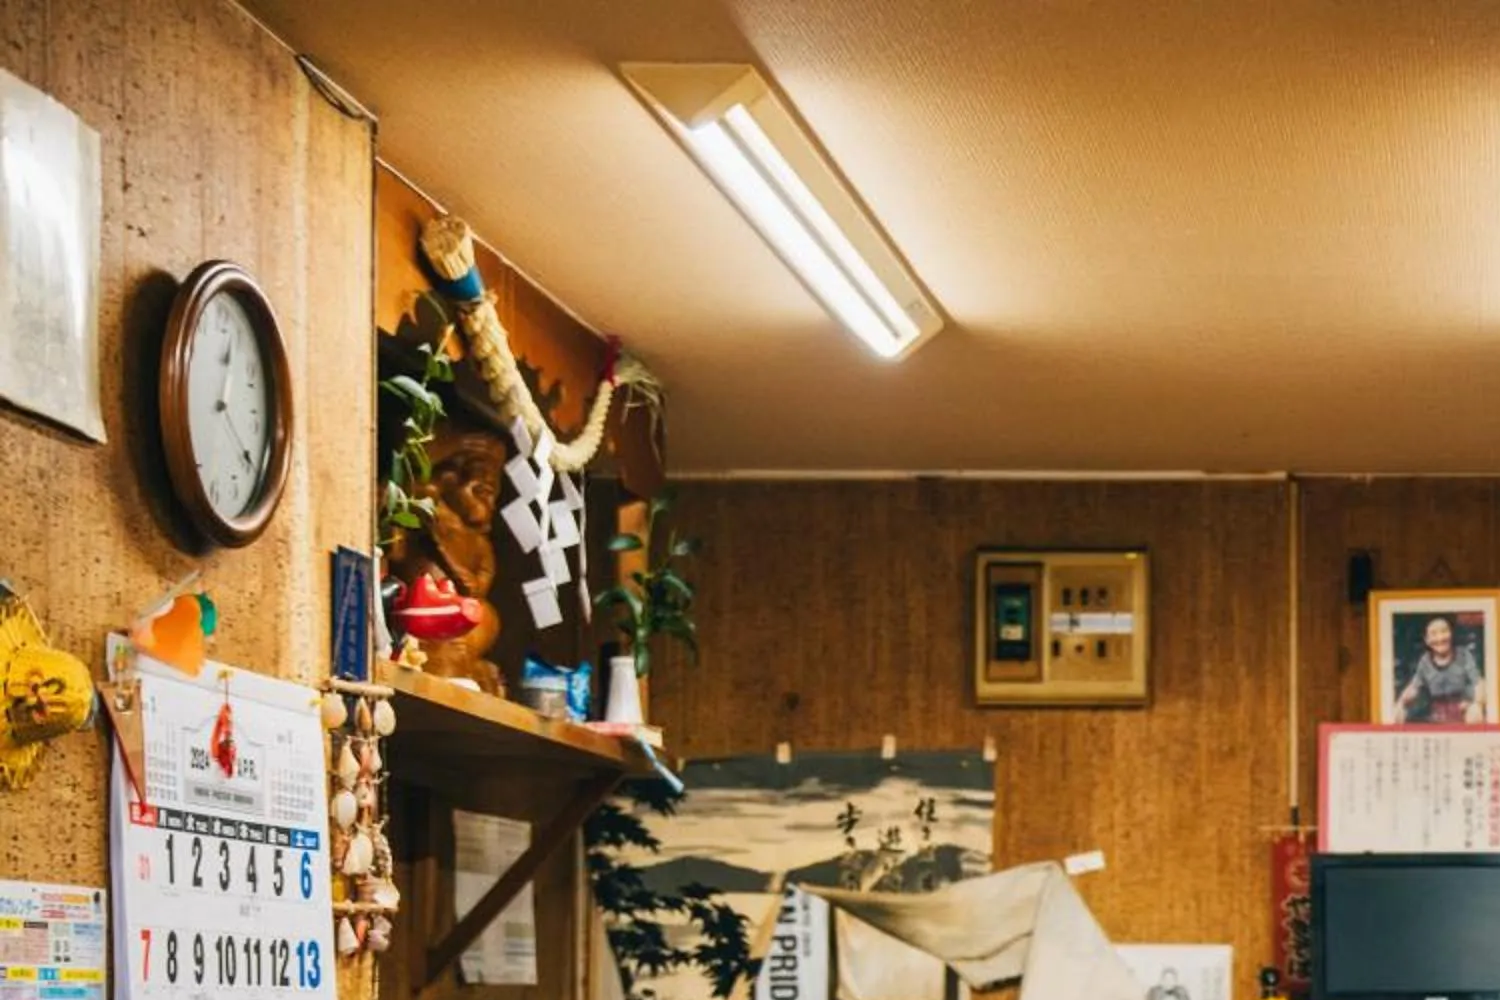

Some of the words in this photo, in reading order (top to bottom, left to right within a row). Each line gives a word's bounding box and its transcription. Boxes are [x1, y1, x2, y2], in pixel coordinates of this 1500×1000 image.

[166, 834, 175, 884] 1
[192, 837, 203, 887] 2
[219, 841, 230, 891] 3
[246, 846, 258, 893] 4
[273, 849, 284, 896] 5
[300, 852, 312, 899] 6
[140, 930, 151, 982] 7
[167, 930, 177, 983] 8
[193, 933, 204, 984] 9
[216, 935, 237, 986] 10
[244, 937, 262, 986] 11
[270, 938, 291, 987] 12
[296, 940, 321, 988] 13
